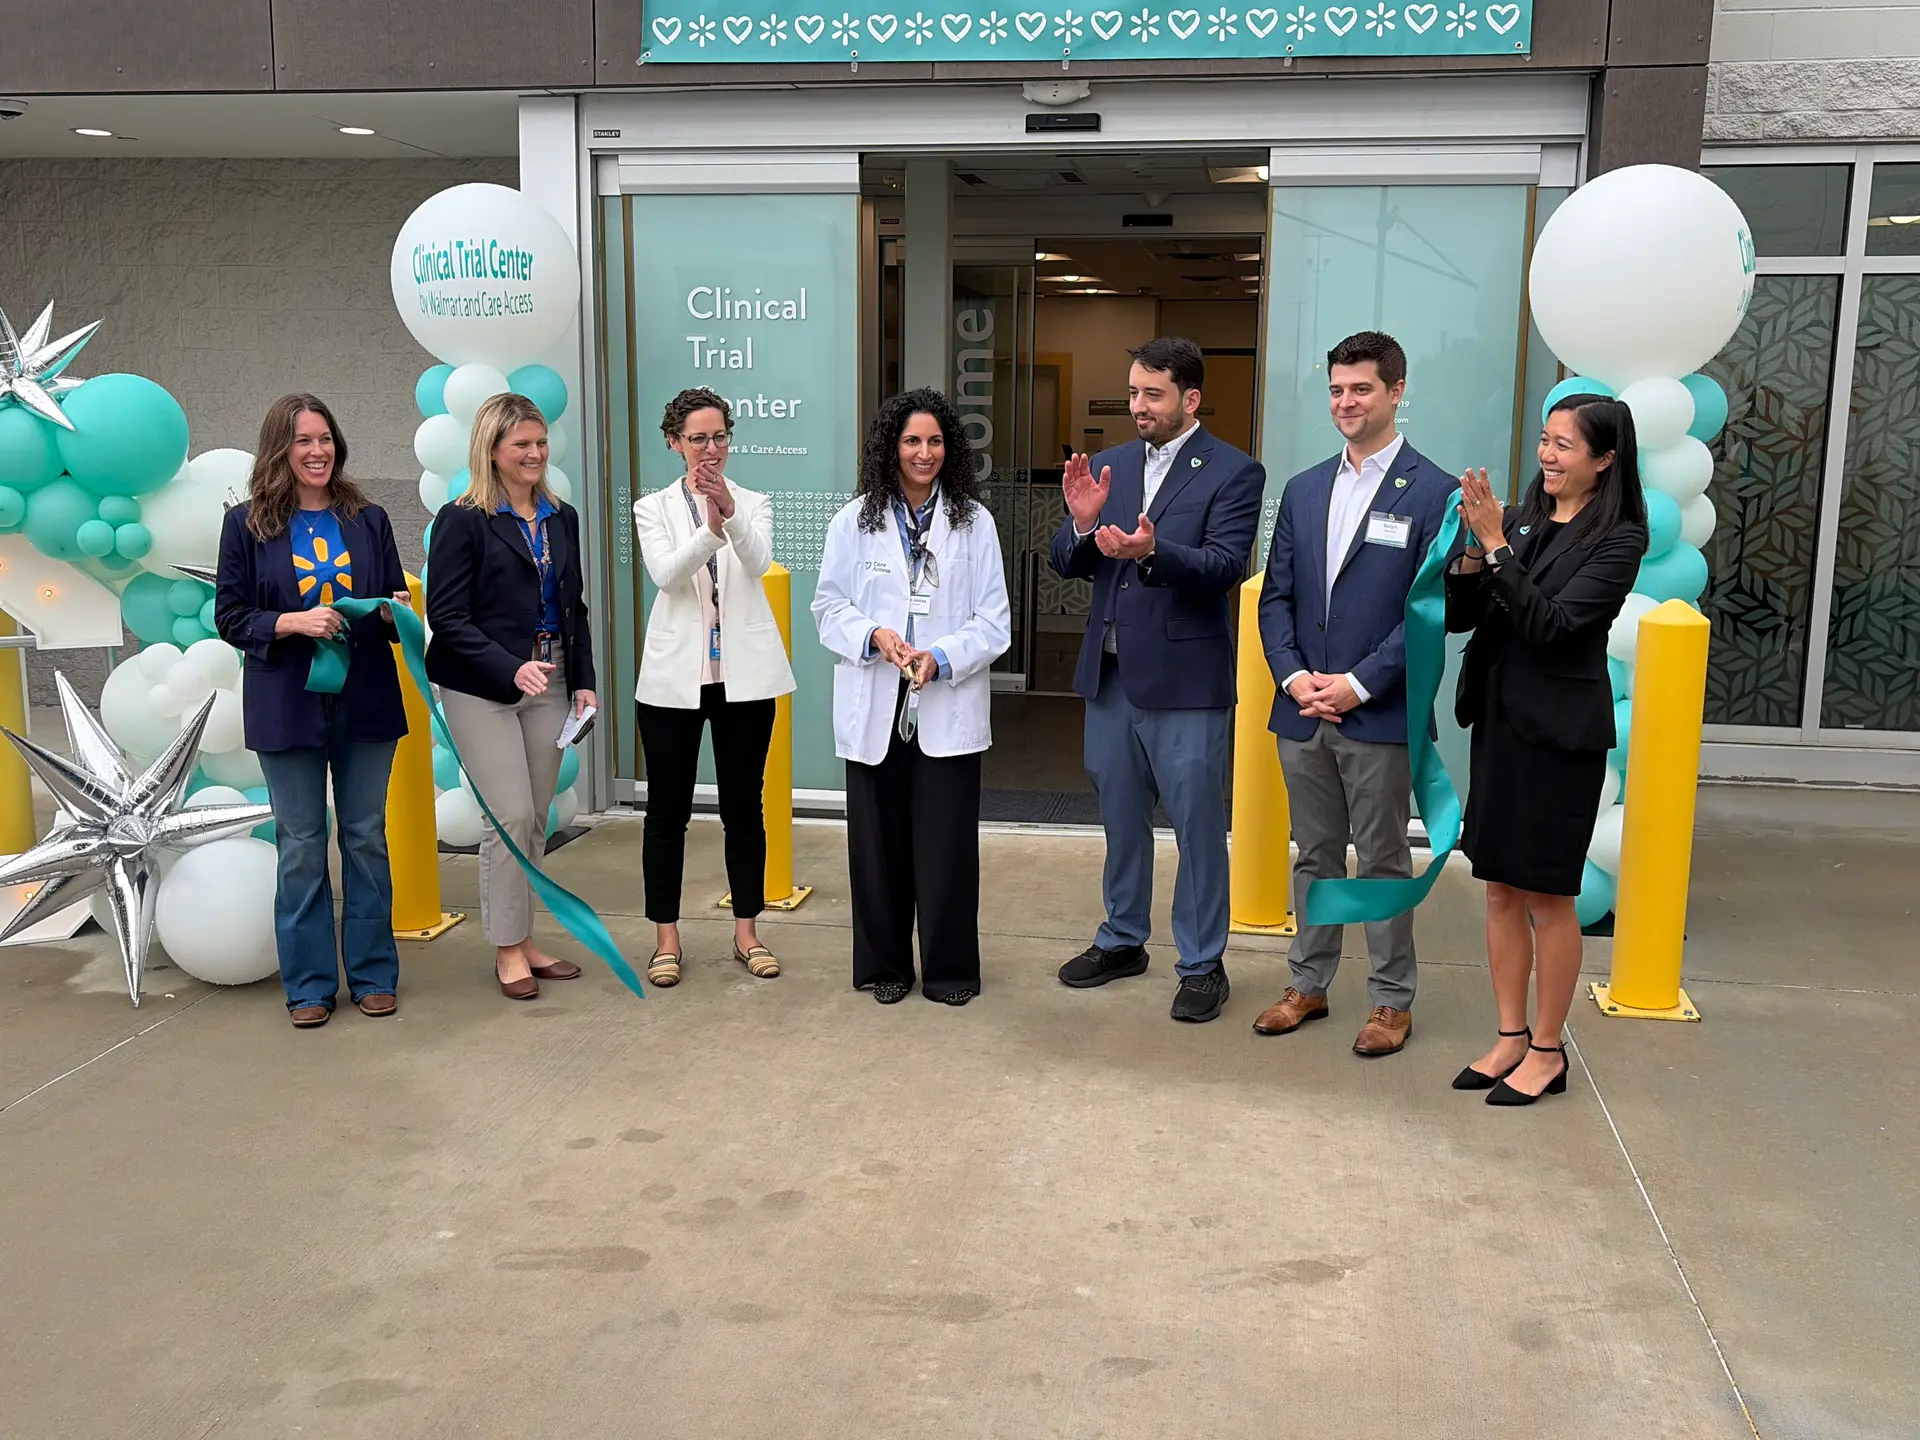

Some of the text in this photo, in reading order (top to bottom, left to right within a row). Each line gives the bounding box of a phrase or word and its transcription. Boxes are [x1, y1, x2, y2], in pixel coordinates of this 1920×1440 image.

[412, 238, 534, 285] Clinical Trial Center
[428, 290, 463, 317] Walmart
[463, 290, 481, 317] and
[481, 291, 503, 317] Care
[504, 290, 534, 315] Access
[687, 286, 807, 319] Clinical
[686, 336, 753, 368] Trial
[694, 385, 803, 418] nter
[956, 308, 994, 499] come
[741, 445, 749, 454] &
[750, 444, 774, 454] Care
[775, 445, 808, 455] Access
